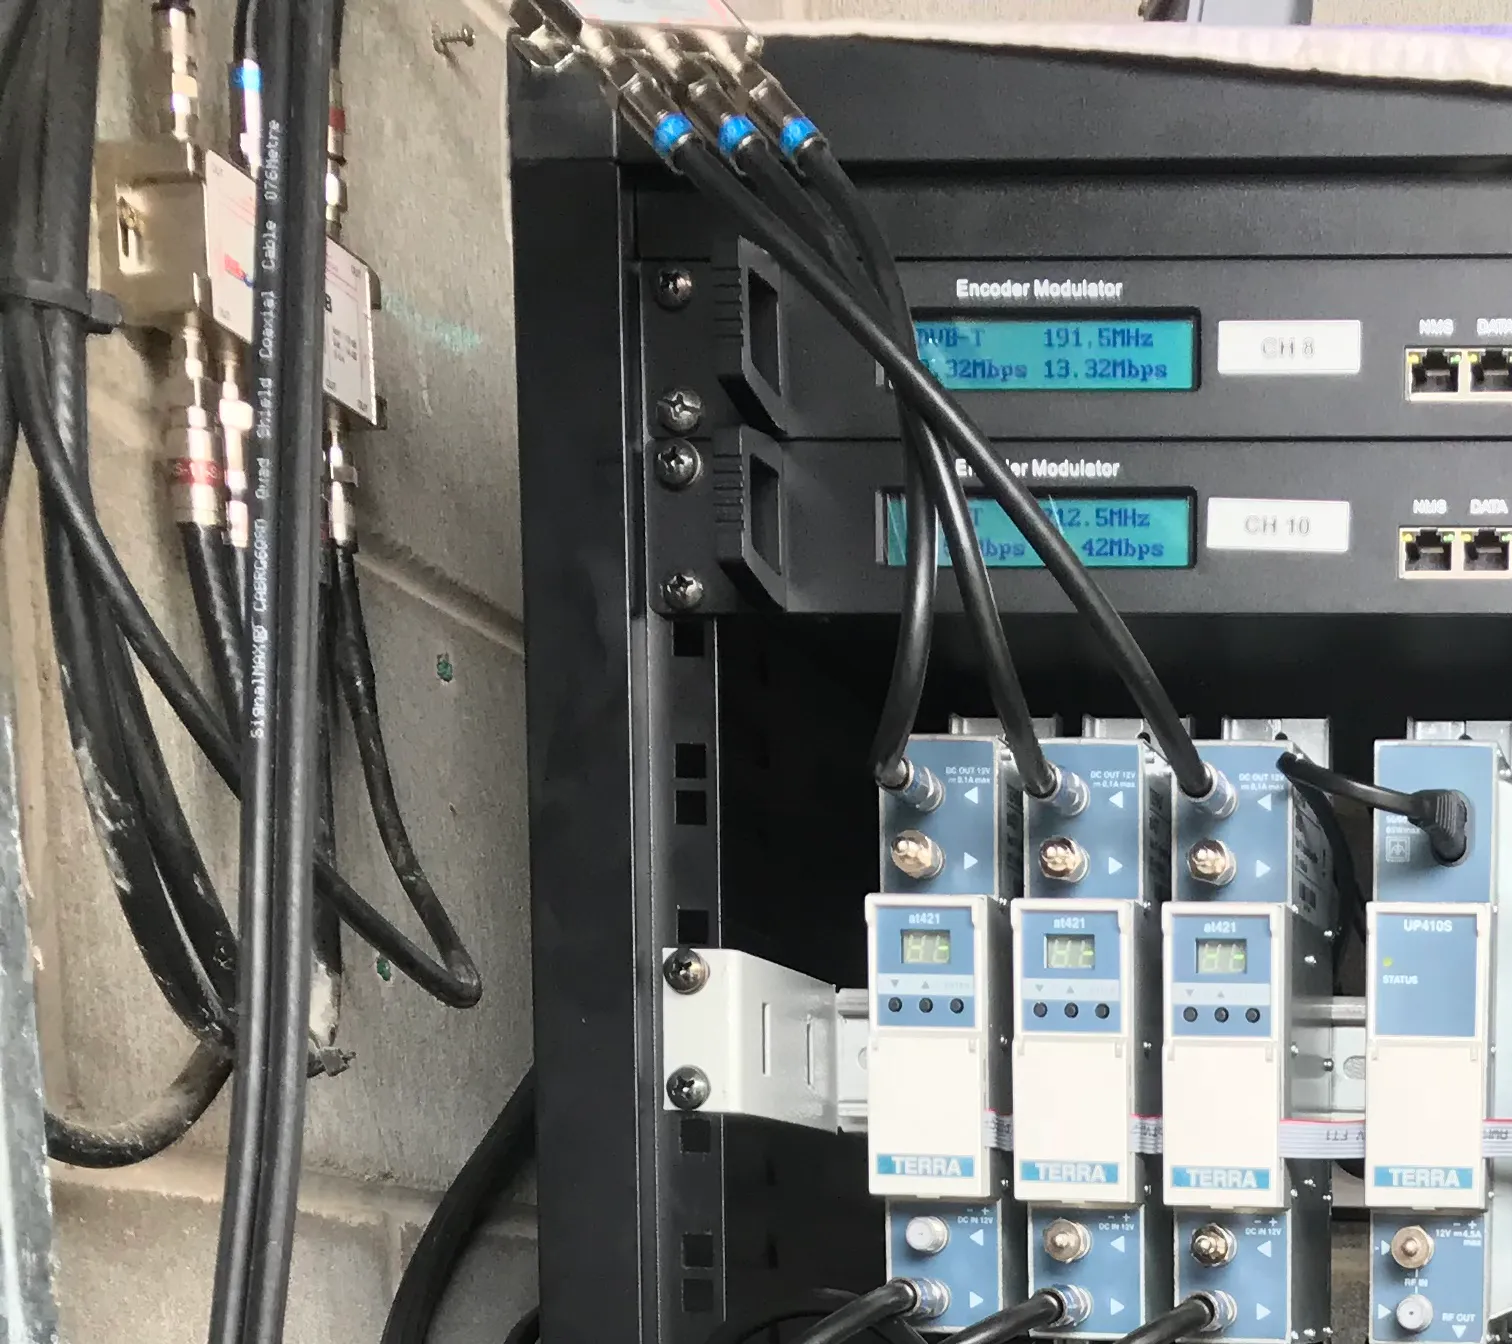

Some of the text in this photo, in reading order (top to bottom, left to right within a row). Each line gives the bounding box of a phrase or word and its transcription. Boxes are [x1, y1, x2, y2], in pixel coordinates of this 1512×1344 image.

[262, 220, 277, 270] Cable
[956, 279, 1123, 298] Encoder Modulator
[259, 290, 275, 358] Coaxial
[1419, 318, 1454, 335] NMS
[1044, 328, 1153, 348] 191.5MHz
[1261, 337, 1296, 358] CH
[1045, 358, 1168, 382] 13.32Mbps
[1032, 459, 1120, 477] Modulator
[1413, 499, 1447, 514] NMS
[1470, 499, 1509, 514] DATA
[1244, 516, 1311, 534] CH 10
[909, 912, 940, 925] at421
[1053, 916, 1086, 929] at421
[1204, 921, 1236, 933] at421
[1404, 919, 1452, 932] UP410S
[1383, 975, 1418, 984] STATUS
[892, 1156, 962, 1177] TERRA
[1035, 1162, 1107, 1184] TERRA
[1186, 1167, 1257, 1189] TERRA
[1389, 1168, 1461, 1188] TERRA
[1245, 1227, 1257, 1236] DC
[1268, 1227, 1282, 1236] 12V
[1442, 1313, 1476, 1322] RF OUT
